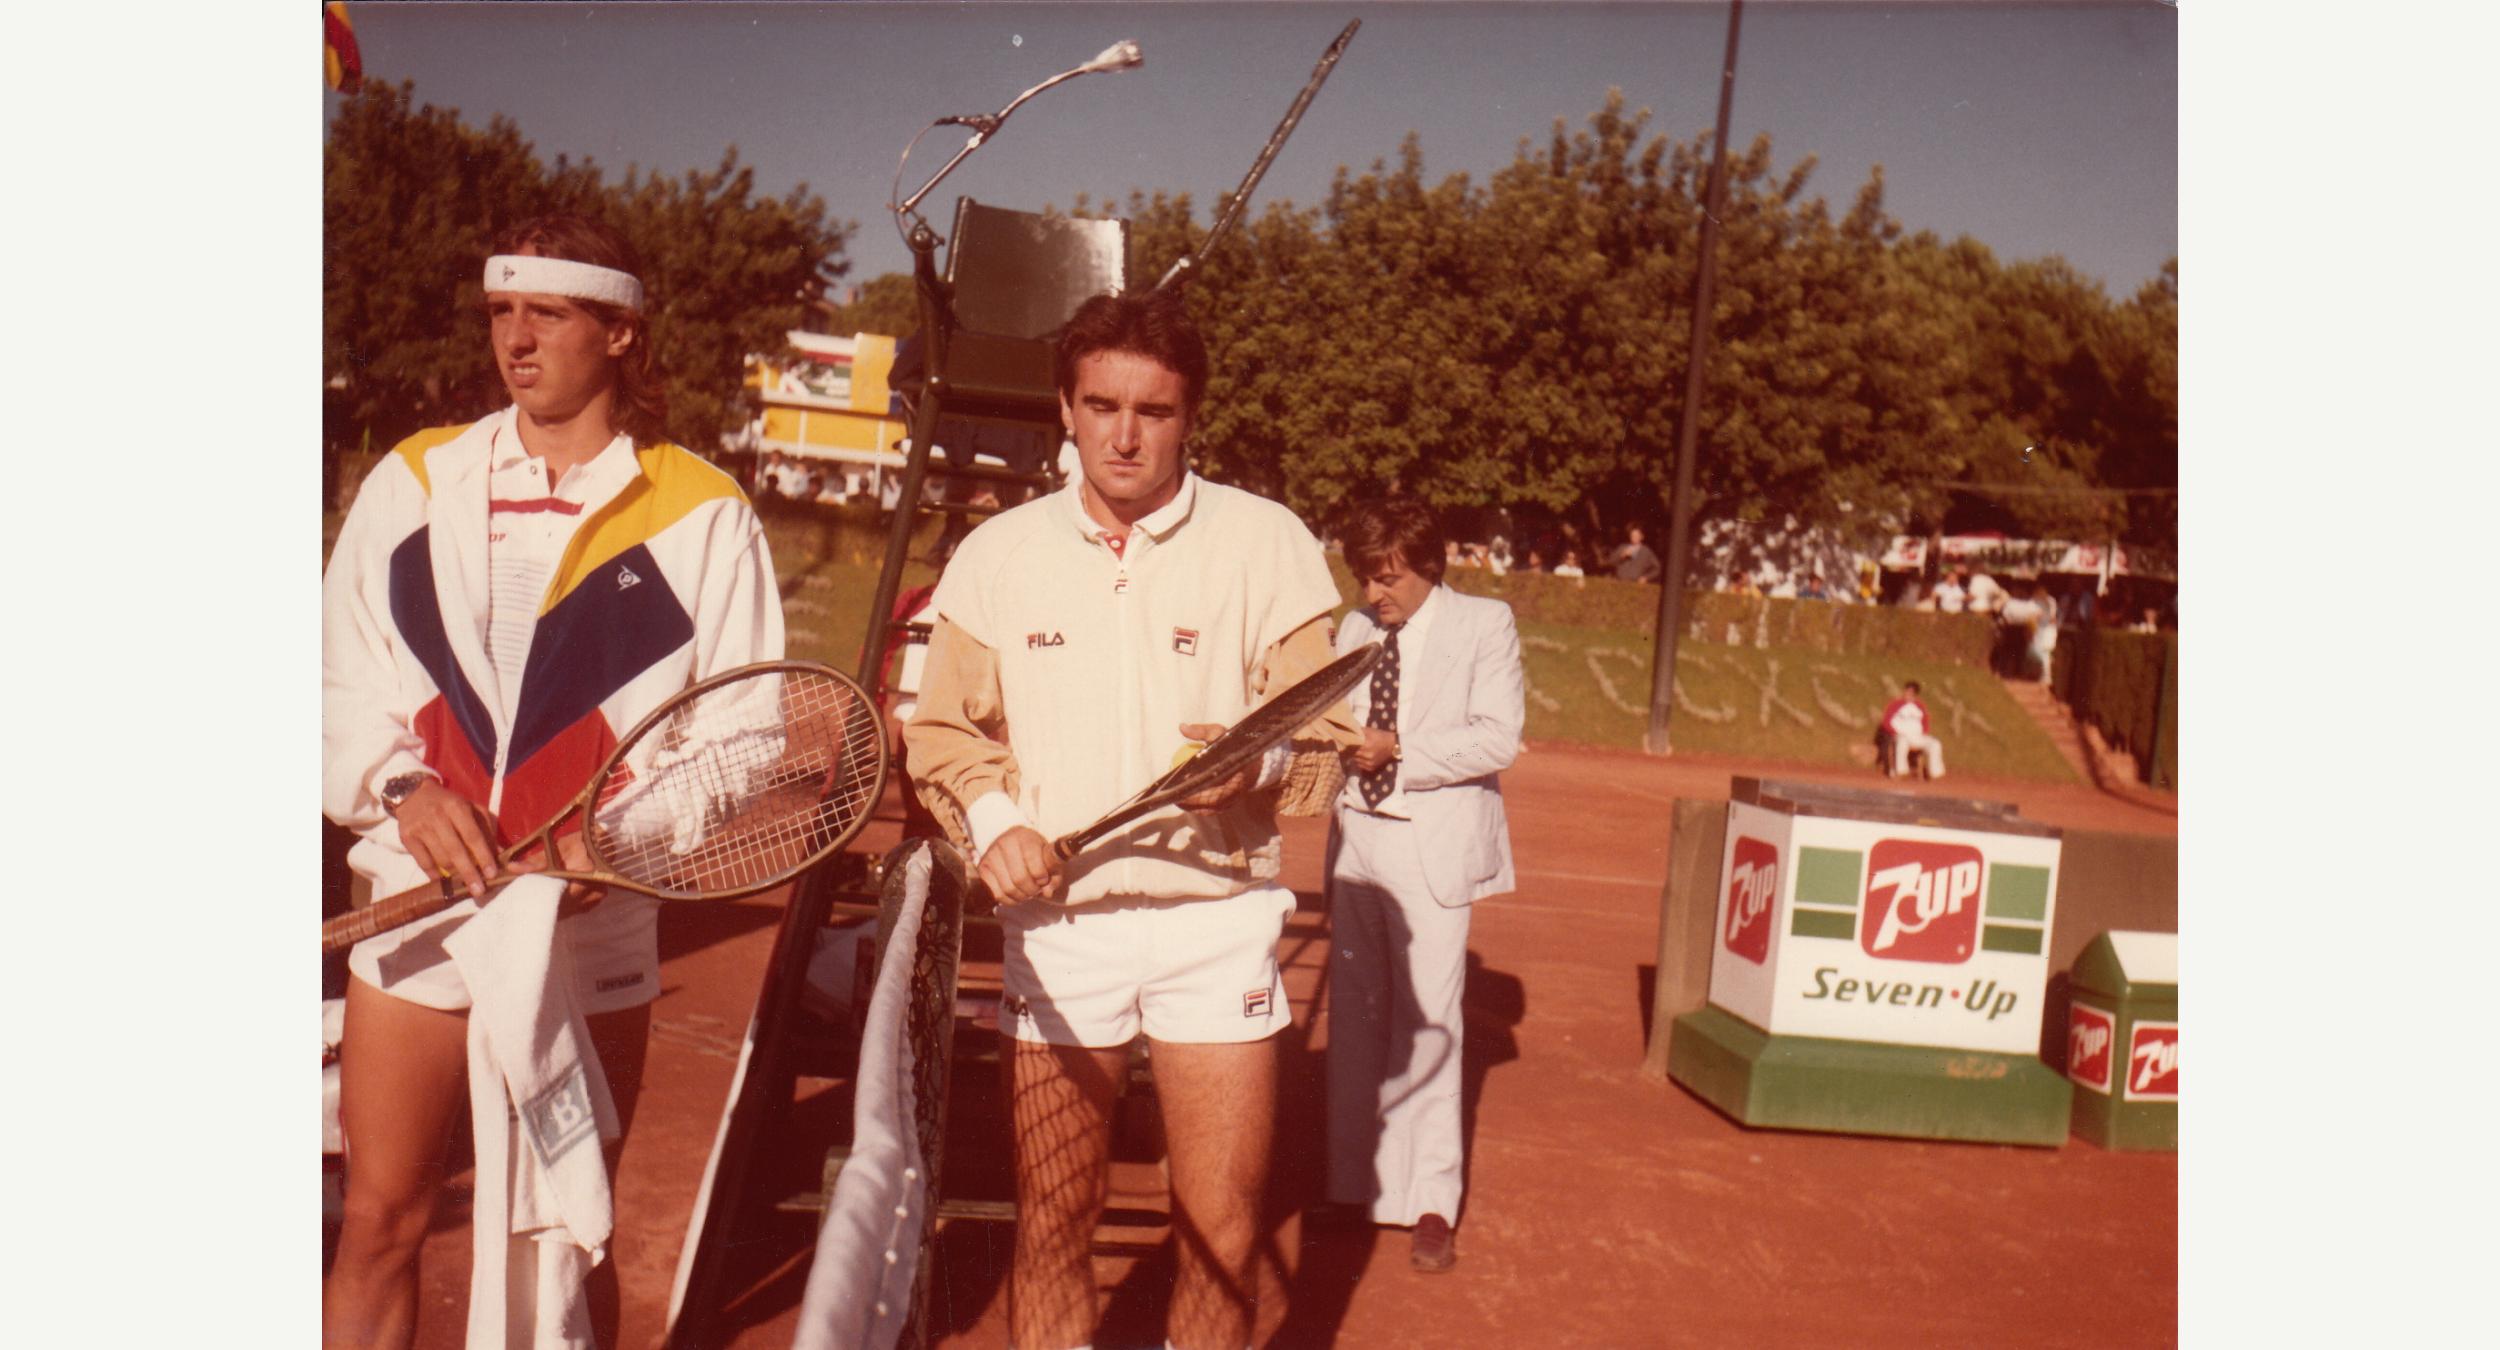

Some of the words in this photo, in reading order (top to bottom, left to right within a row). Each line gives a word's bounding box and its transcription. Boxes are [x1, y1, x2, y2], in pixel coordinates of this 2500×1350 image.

[1026, 631, 1065, 650] FILA
[1727, 860, 1776, 943] 7UP
[1870, 860, 1980, 952] 7UP
[2134, 1039, 2178, 1092] 7U
